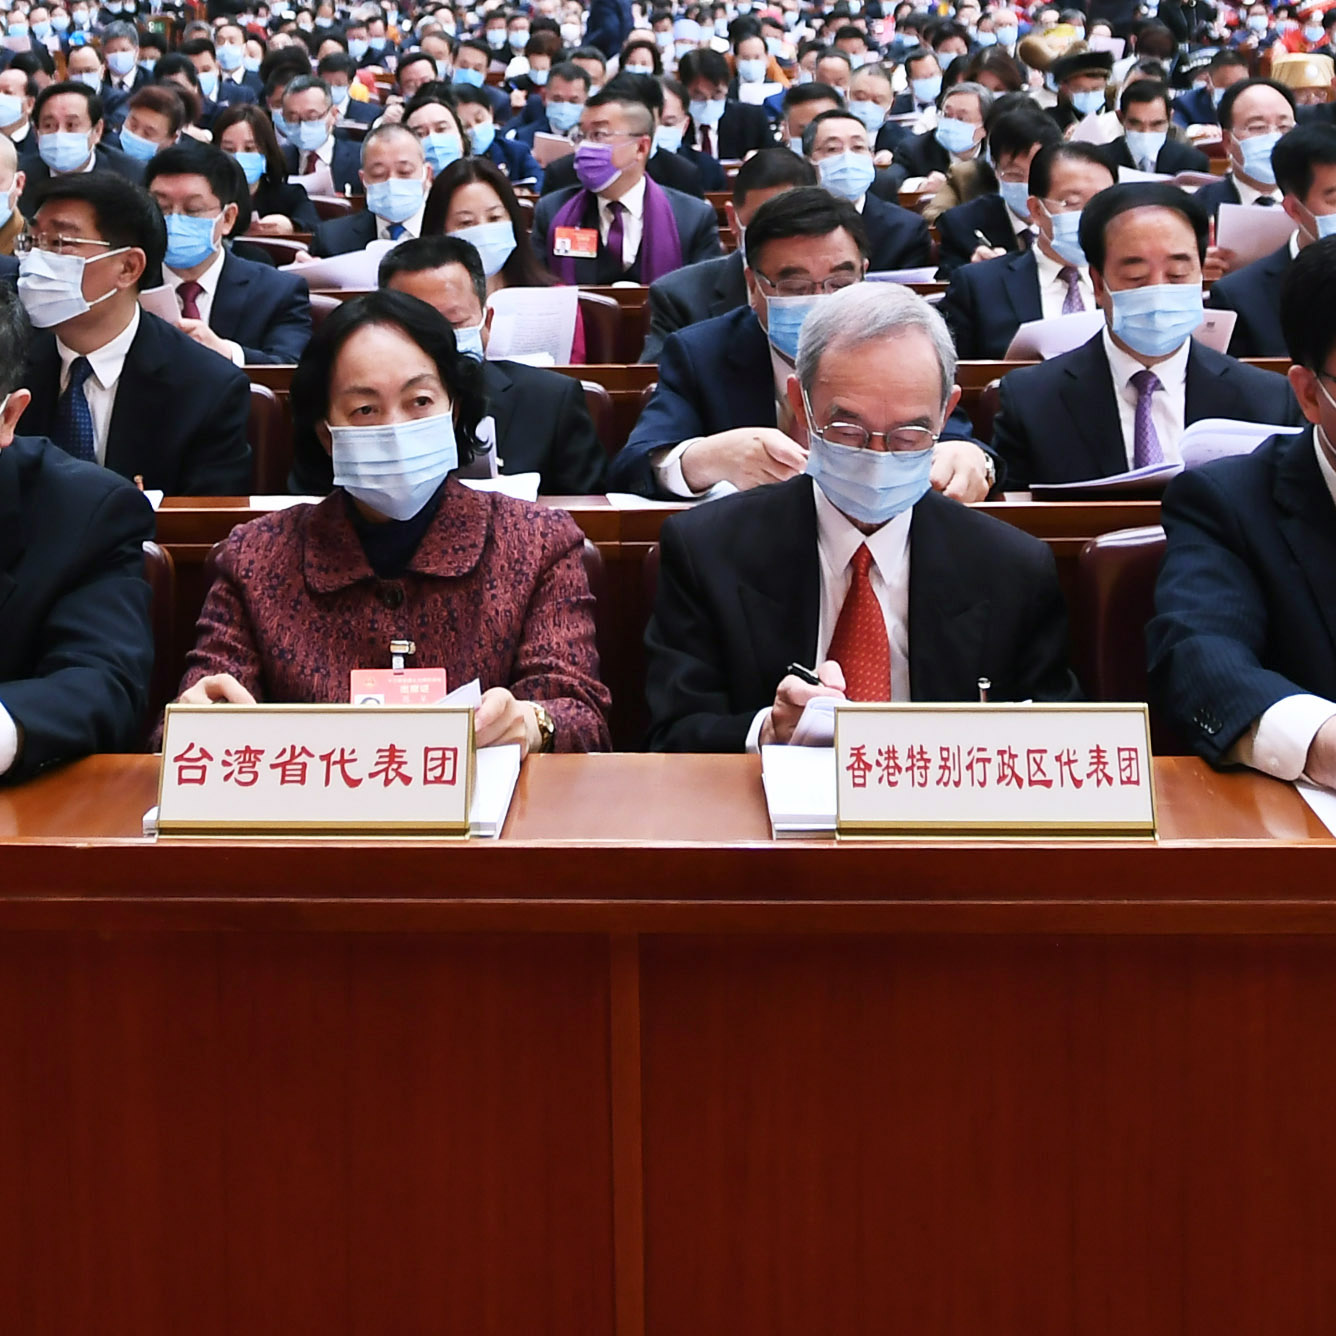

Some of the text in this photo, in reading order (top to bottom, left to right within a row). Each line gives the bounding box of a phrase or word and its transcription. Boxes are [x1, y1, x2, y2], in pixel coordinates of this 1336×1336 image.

[173, 742, 459, 789] 台湾省代表团
[846, 744, 1141, 790] 香港特别行政区代表团
